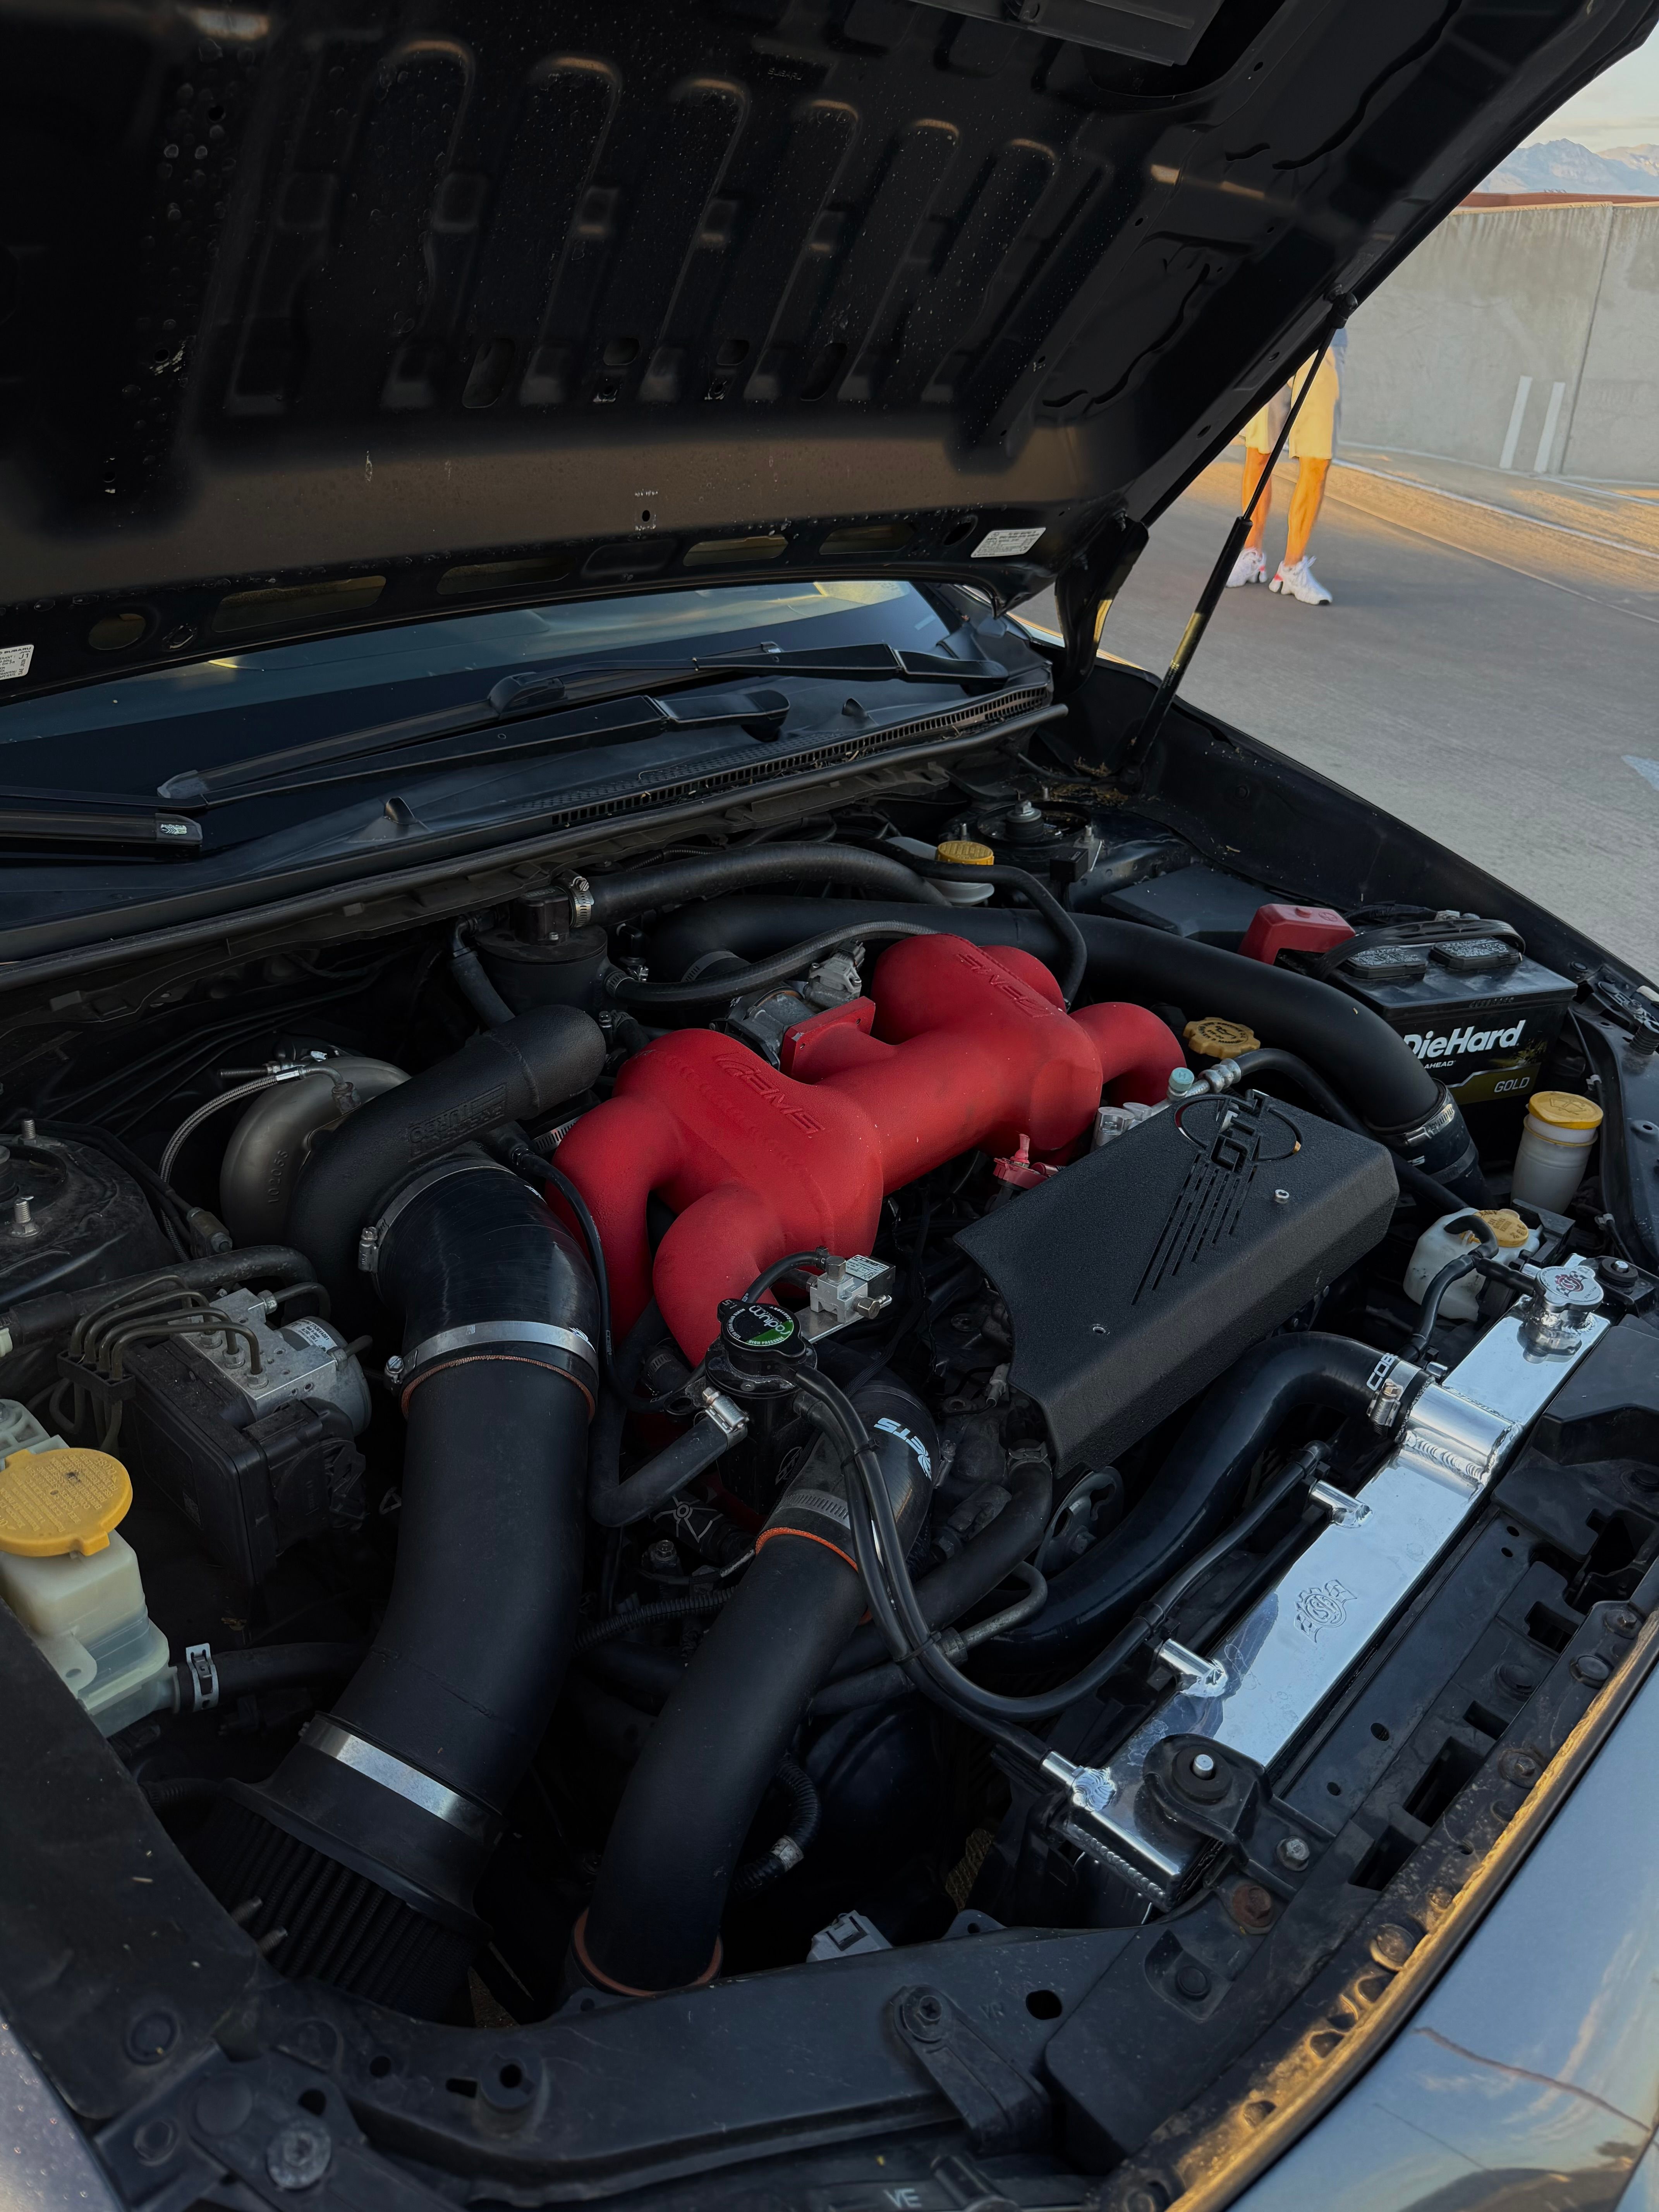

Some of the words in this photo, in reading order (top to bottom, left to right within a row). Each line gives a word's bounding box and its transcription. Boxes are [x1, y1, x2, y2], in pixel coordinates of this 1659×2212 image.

[1403, 1019, 1527, 1060] DieHard
[1494, 1077, 1530, 1093] GOLD
[749, 1305, 791, 1335] radium
[874, 1417, 926, 1455] ETS
[94, 1455, 118, 1477] CLOSE
